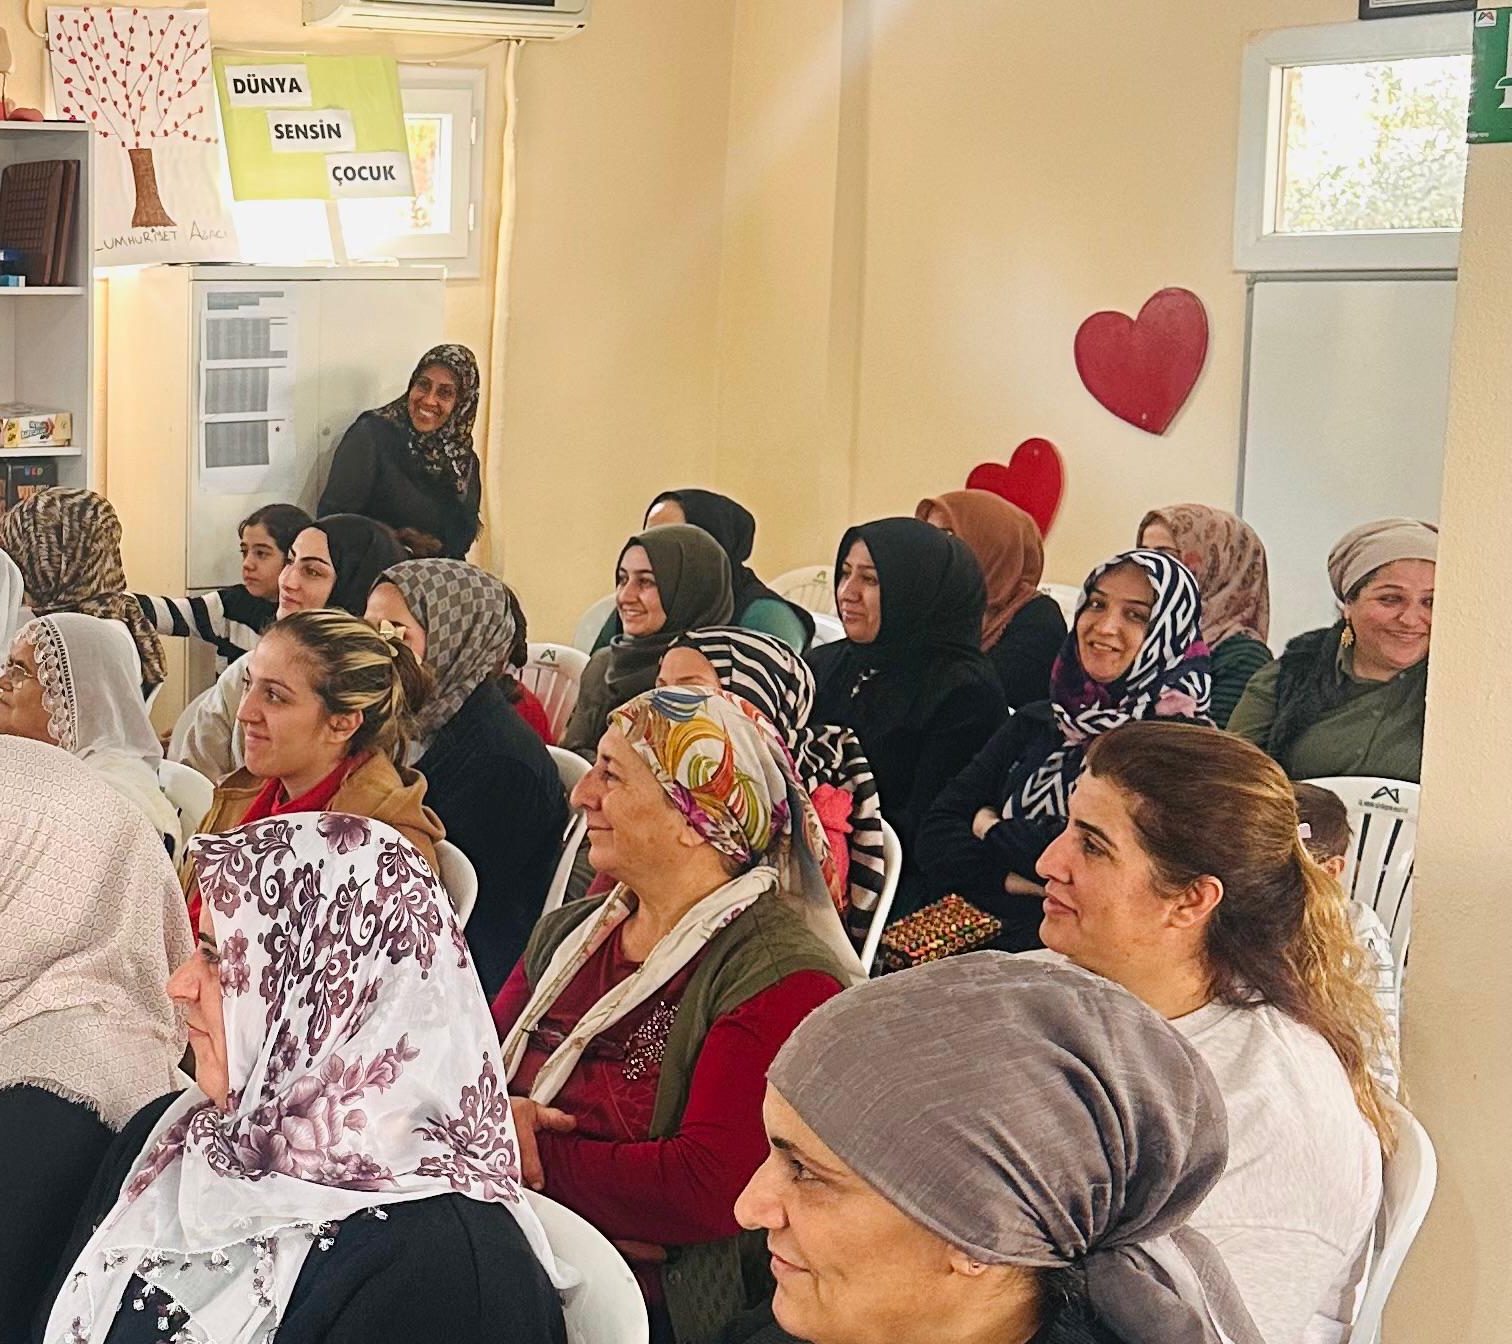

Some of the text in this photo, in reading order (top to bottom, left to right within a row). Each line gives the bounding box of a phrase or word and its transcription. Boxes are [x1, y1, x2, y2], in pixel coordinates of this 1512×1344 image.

[232, 73, 303, 94] DÜNYA
[274, 119, 342, 140] SENSİN
[332, 165, 396, 186] ÇOCUK
